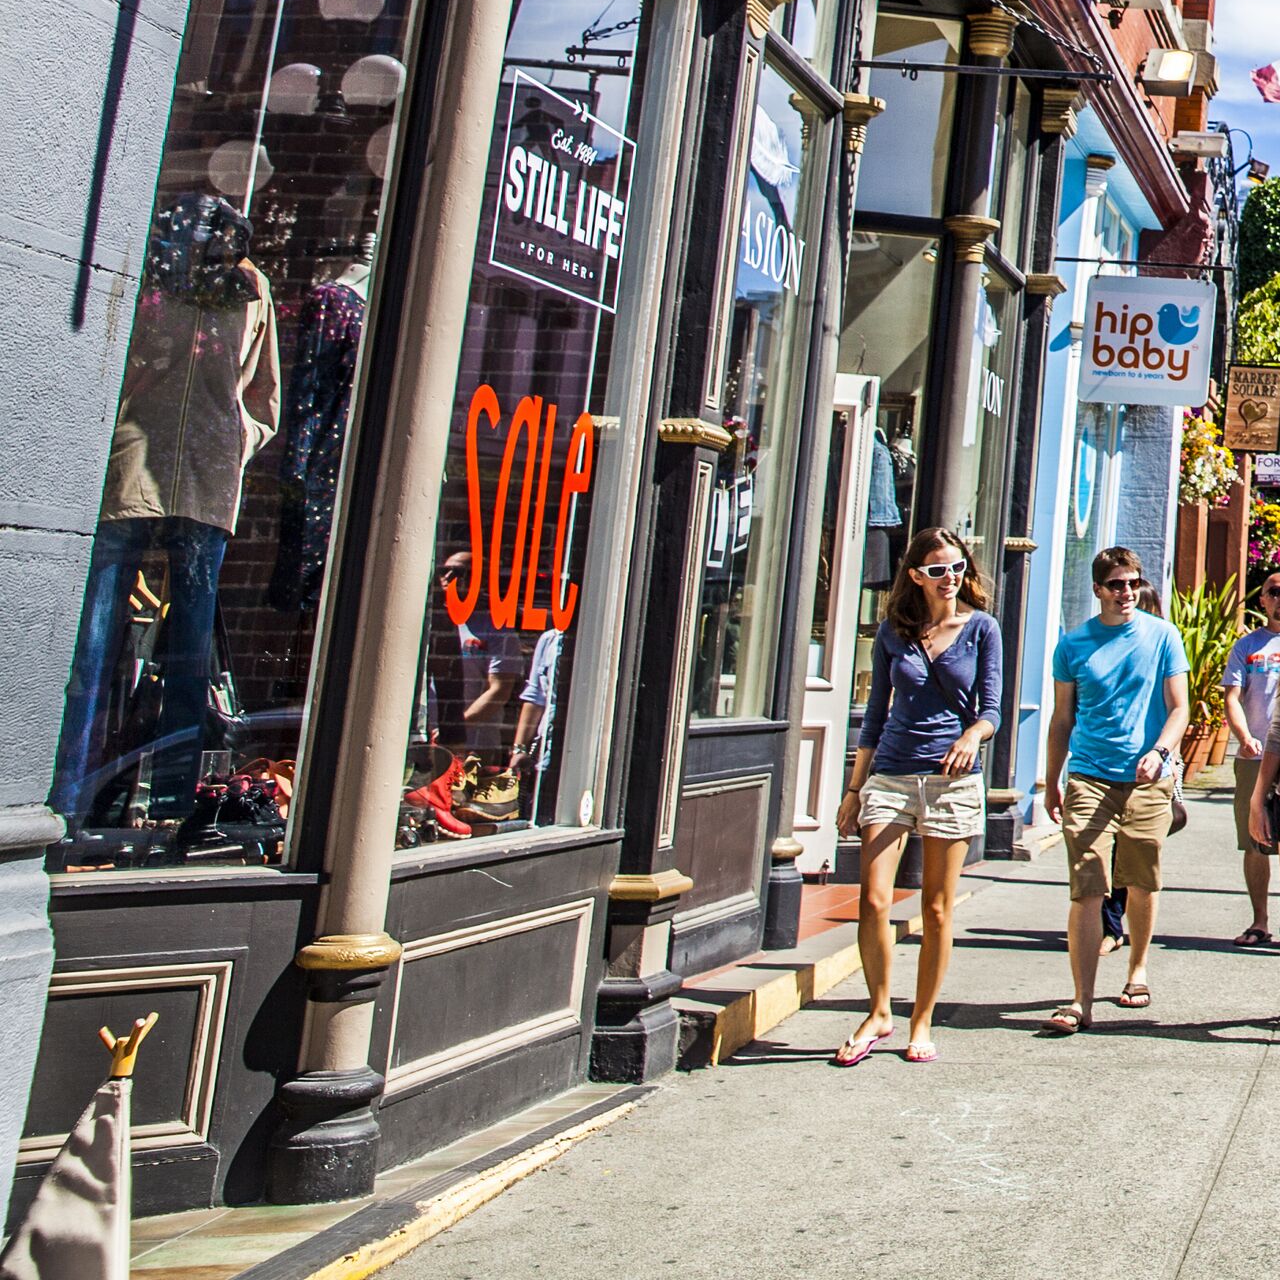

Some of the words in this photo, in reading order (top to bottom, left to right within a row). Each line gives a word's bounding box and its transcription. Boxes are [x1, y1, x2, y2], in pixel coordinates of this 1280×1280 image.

[505, 145, 570, 236] STILL
[572, 178, 625, 260] LIFE
[527, 246, 554, 265] FOR
[562, 258, 588, 280] HER
[1095, 301, 1153, 345] hip
[1092, 334, 1190, 381] baby
[1092, 369, 1126, 377] newborn
[1128, 370, 1136, 378] to
[1234, 372, 1278, 384] MARKET
[1233, 384, 1276, 398] SQUARE
[1257, 458, 1280, 468] FOR
